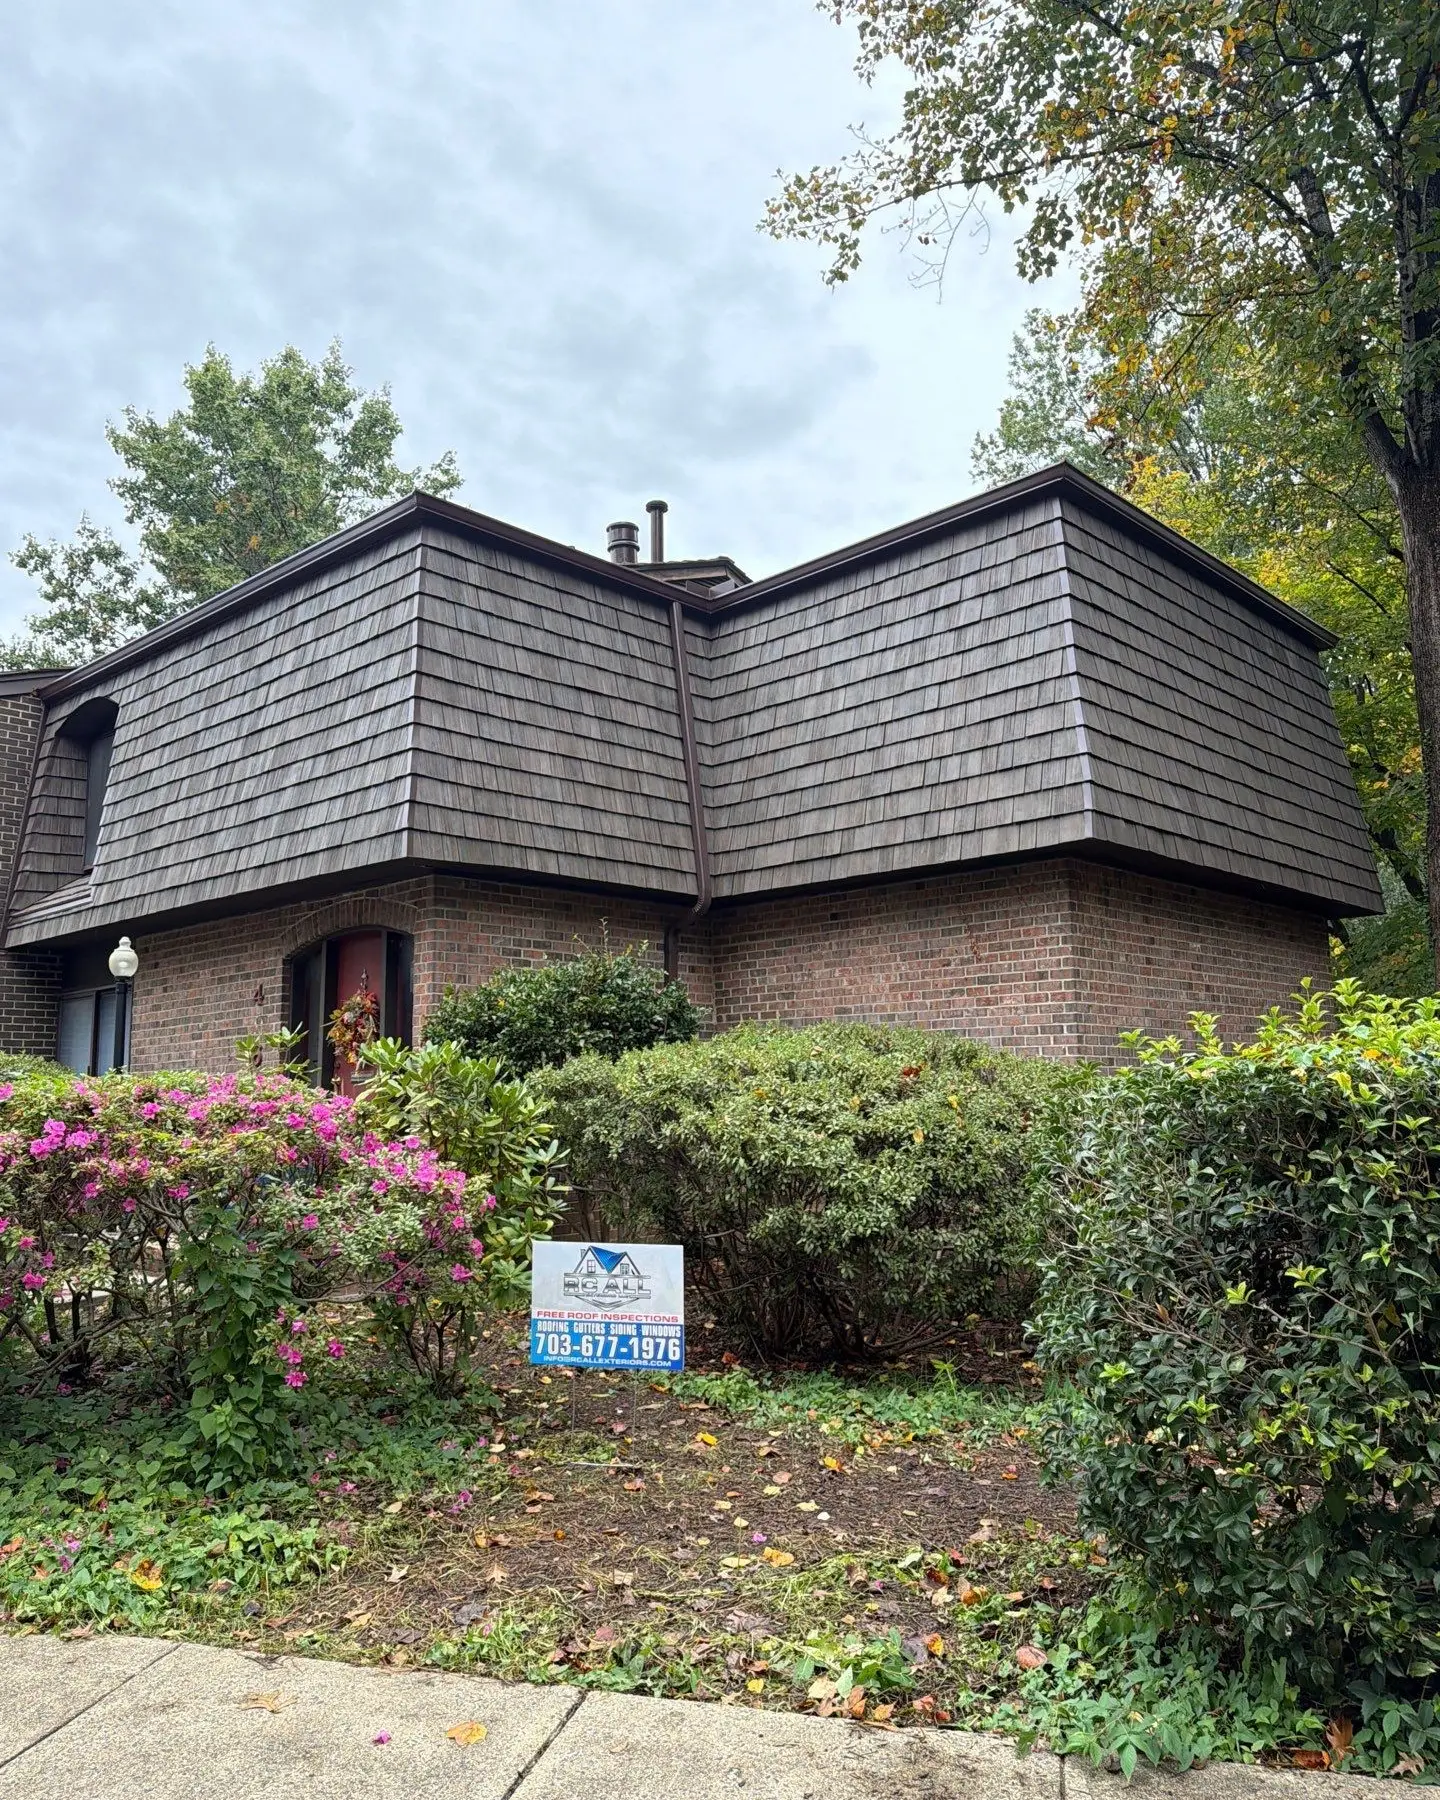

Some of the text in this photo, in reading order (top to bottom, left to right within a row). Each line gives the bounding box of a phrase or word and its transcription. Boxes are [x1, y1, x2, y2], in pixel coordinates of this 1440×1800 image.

[563, 1276, 651, 1295] RC ALL
[601, 1313, 679, 1322] INSPECTIONS
[537, 1321, 681, 1337] ROOFING GUTTERS SIDING WINDOWS
[535, 1333, 681, 1361] 703-677-1976
